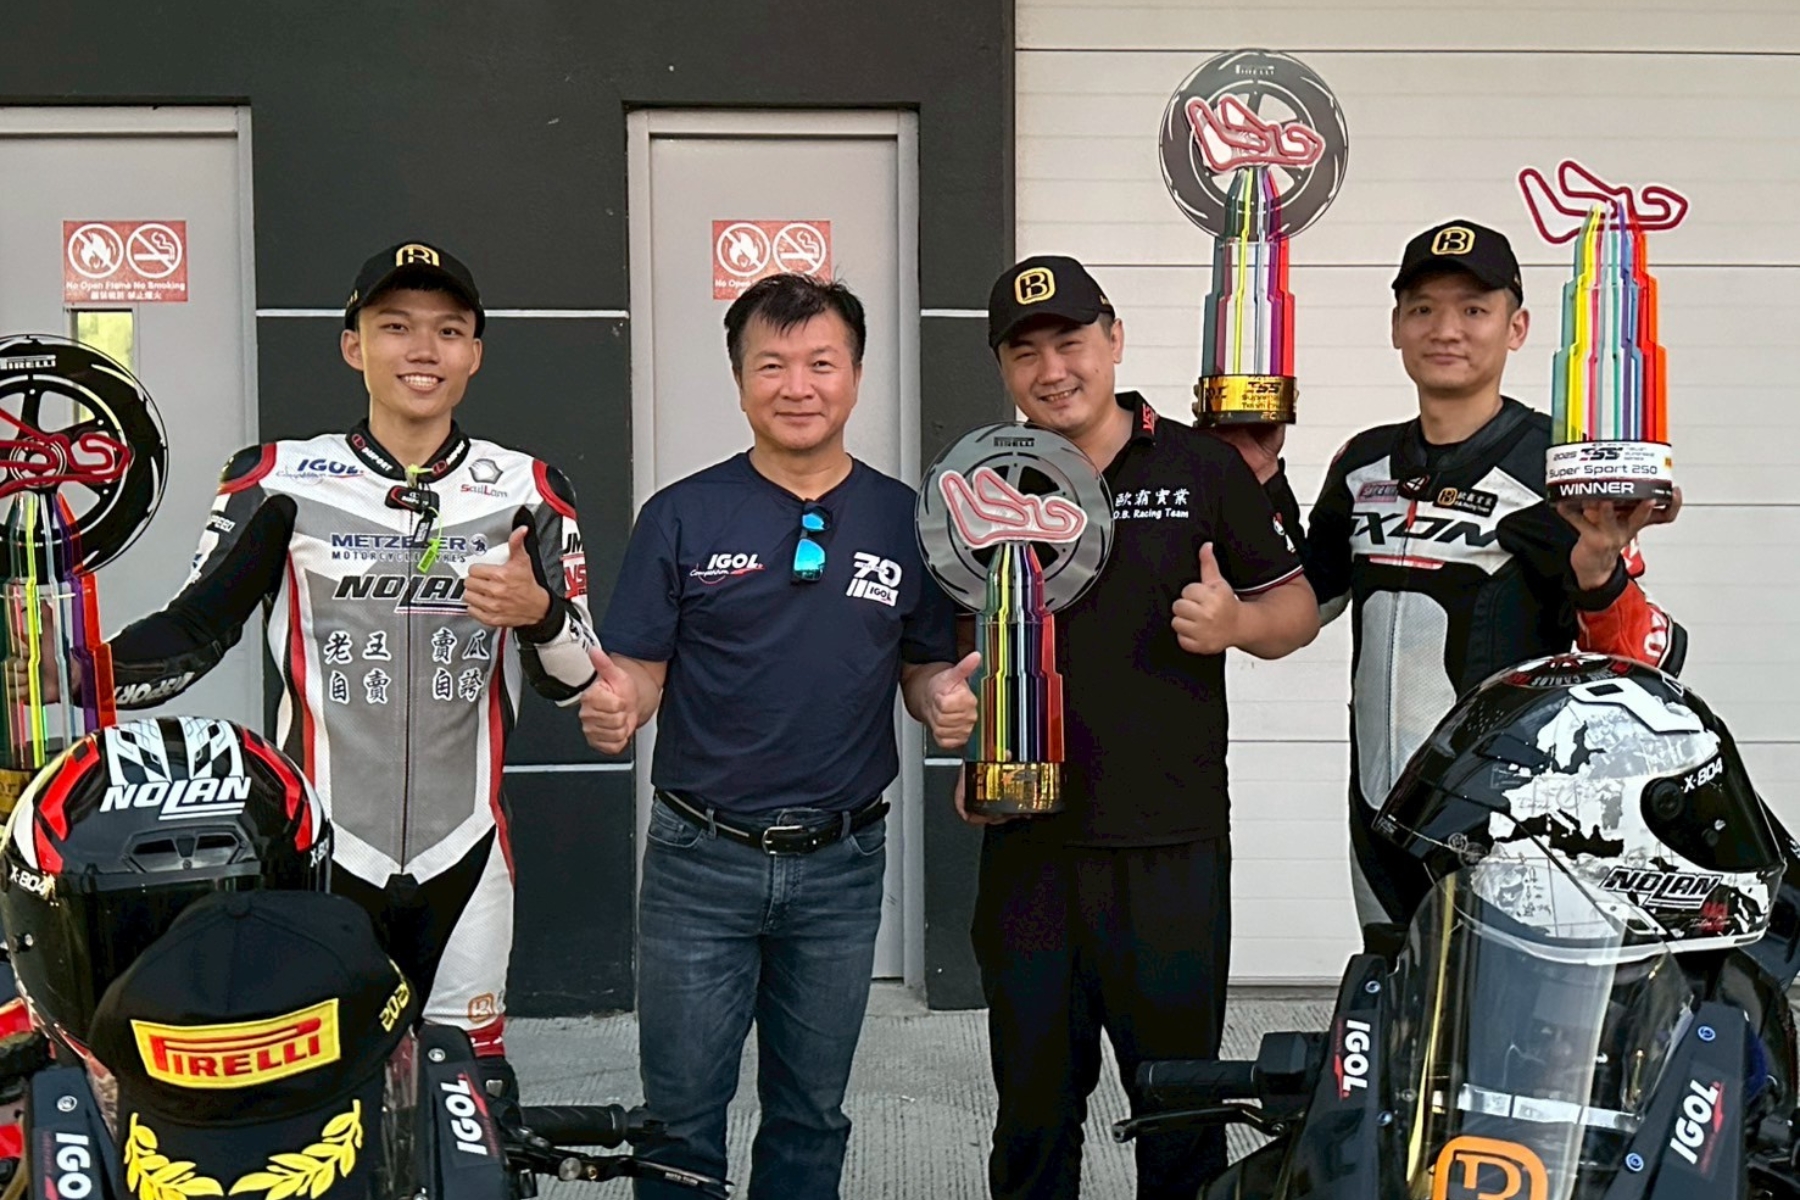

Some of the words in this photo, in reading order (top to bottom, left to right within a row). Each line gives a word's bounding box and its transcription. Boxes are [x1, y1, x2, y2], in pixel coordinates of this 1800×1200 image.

[66, 282, 78, 290] No
[81, 282, 103, 291] Open
[133, 282, 146, 290] No
[148, 281, 186, 291] Smoking
[993, 437, 1035, 447] PIRELLI
[1554, 450, 1578, 461] 2025
[1549, 466, 1580, 479] Super
[1584, 464, 1628, 476] Sport
[1631, 464, 1658, 475] 250
[1560, 482, 1635, 497] WINNER
[1133, 508, 1162, 520] Racing
[1165, 507, 1189, 518] Team
[331, 535, 467, 550] METZEER
[708, 554, 761, 570] IGOL
[869, 586, 893, 600] IGOL
[1684, 758, 1723, 793] X-804
[100, 777, 252, 819] NOLAN
[10, 864, 48, 896] X-804
[1601, 867, 1723, 909] NOLAN
[150, 1017, 322, 1077] PIRELLI
[1342, 1019, 1371, 1093] IGOL
[440, 1078, 489, 1156] IGOL
[1669, 1080, 1721, 1165] IGOL
[55, 1132, 93, 1200] IGO
